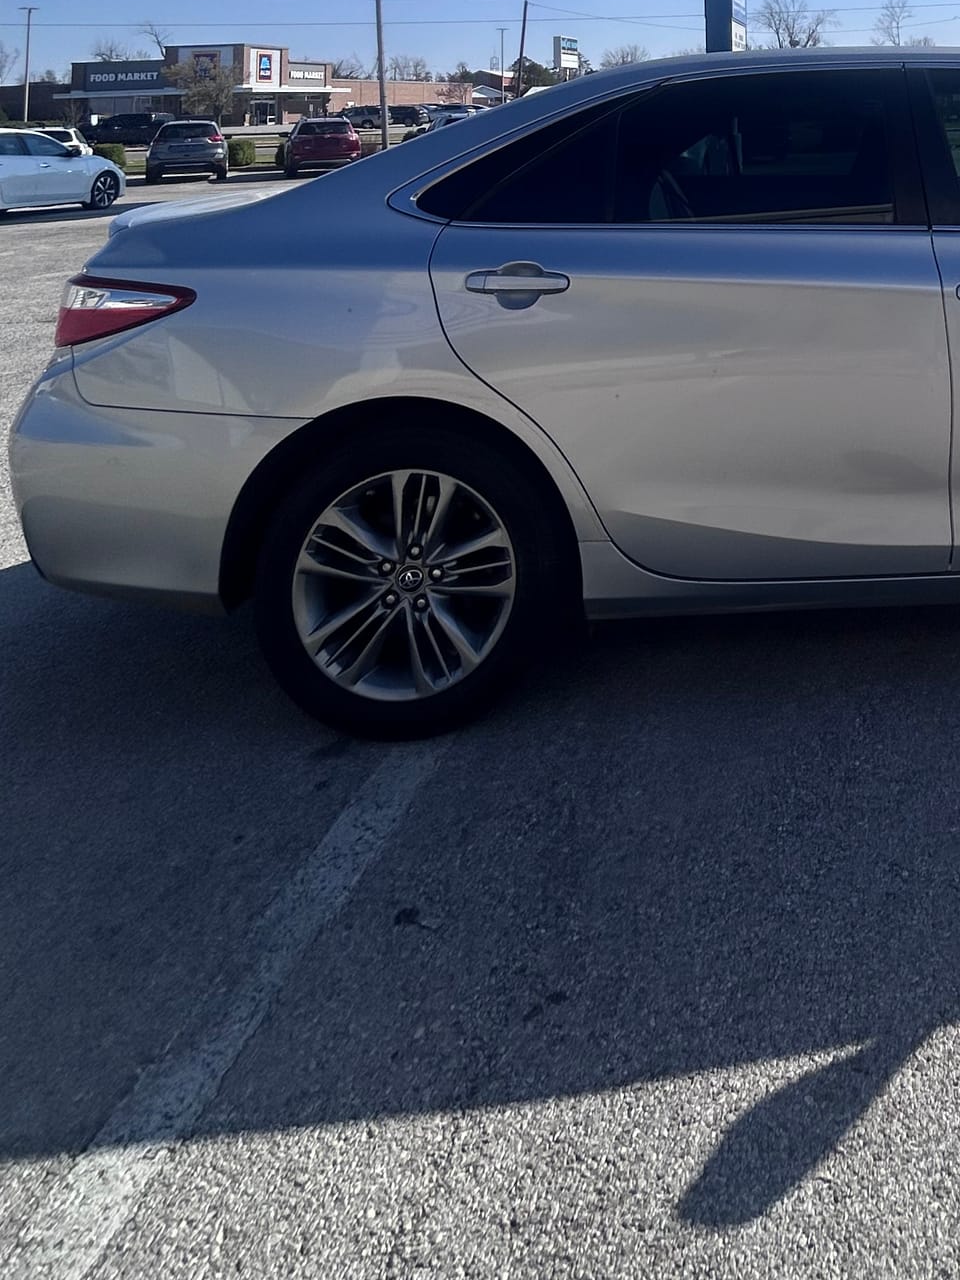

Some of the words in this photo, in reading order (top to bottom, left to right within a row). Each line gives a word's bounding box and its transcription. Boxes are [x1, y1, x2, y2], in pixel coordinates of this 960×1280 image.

[90, 73, 116, 82] FOOD
[117, 72, 158, 81] MARKET
[290, 70, 304, 79] FOOD
[304, 71, 324, 80] MARKET
